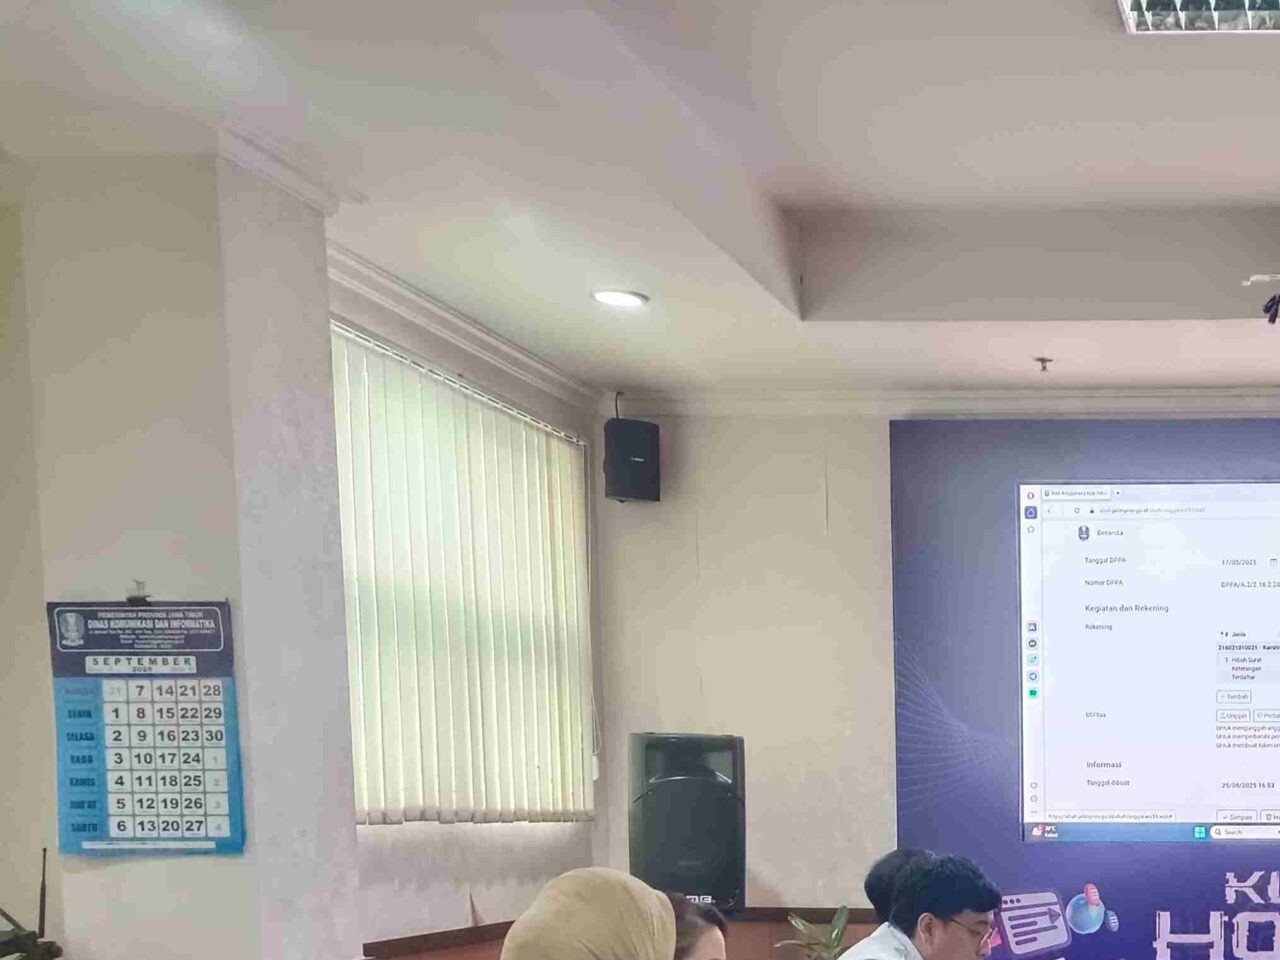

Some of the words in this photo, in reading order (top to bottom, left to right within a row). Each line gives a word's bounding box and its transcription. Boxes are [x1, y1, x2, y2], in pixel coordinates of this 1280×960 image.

[1085, 605, 1118, 613] Kegiatan
[1135, 604, 1169, 613] Rekening
[88, 620, 109, 629] DINAS
[110, 620, 153, 629] KOMUNIKASI
[155, 620, 169, 629] DAN
[170, 620, 215, 629] INFORMATIKA
[136, 685, 145, 696] 7
[156, 685, 174, 696] 14
[179, 685, 197, 696] 21
[203, 685, 221, 696] 28
[112, 708, 119, 719] 1
[136, 708, 146, 719] 8
[156, 708, 175, 719] 15
[180, 708, 198, 719] 22
[204, 708, 222, 719] 29
[112, 730, 122, 741] 2
[137, 730, 146, 741] 9
[157, 730, 176, 741] 16
[181, 730, 200, 741] 23
[205, 730, 223, 741] 30
[114, 753, 123, 764] 3
[134, 753, 152, 764] 10
[159, 753, 177, 764] 17
[182, 753, 201, 764] 24
[115, 775, 124, 787] 4
[135, 775, 153, 787] 11
[160, 775, 178, 787] 18
[183, 775, 202, 787] 25
[116, 798, 126, 809] 5
[136, 798, 155, 809] 12
[161, 798, 179, 809] 19
[184, 798, 203, 809] 26
[117, 820, 126, 832] 6
[138, 820, 156, 832] 13
[162, 820, 180, 832] 20
[185, 820, 204, 832] 27
